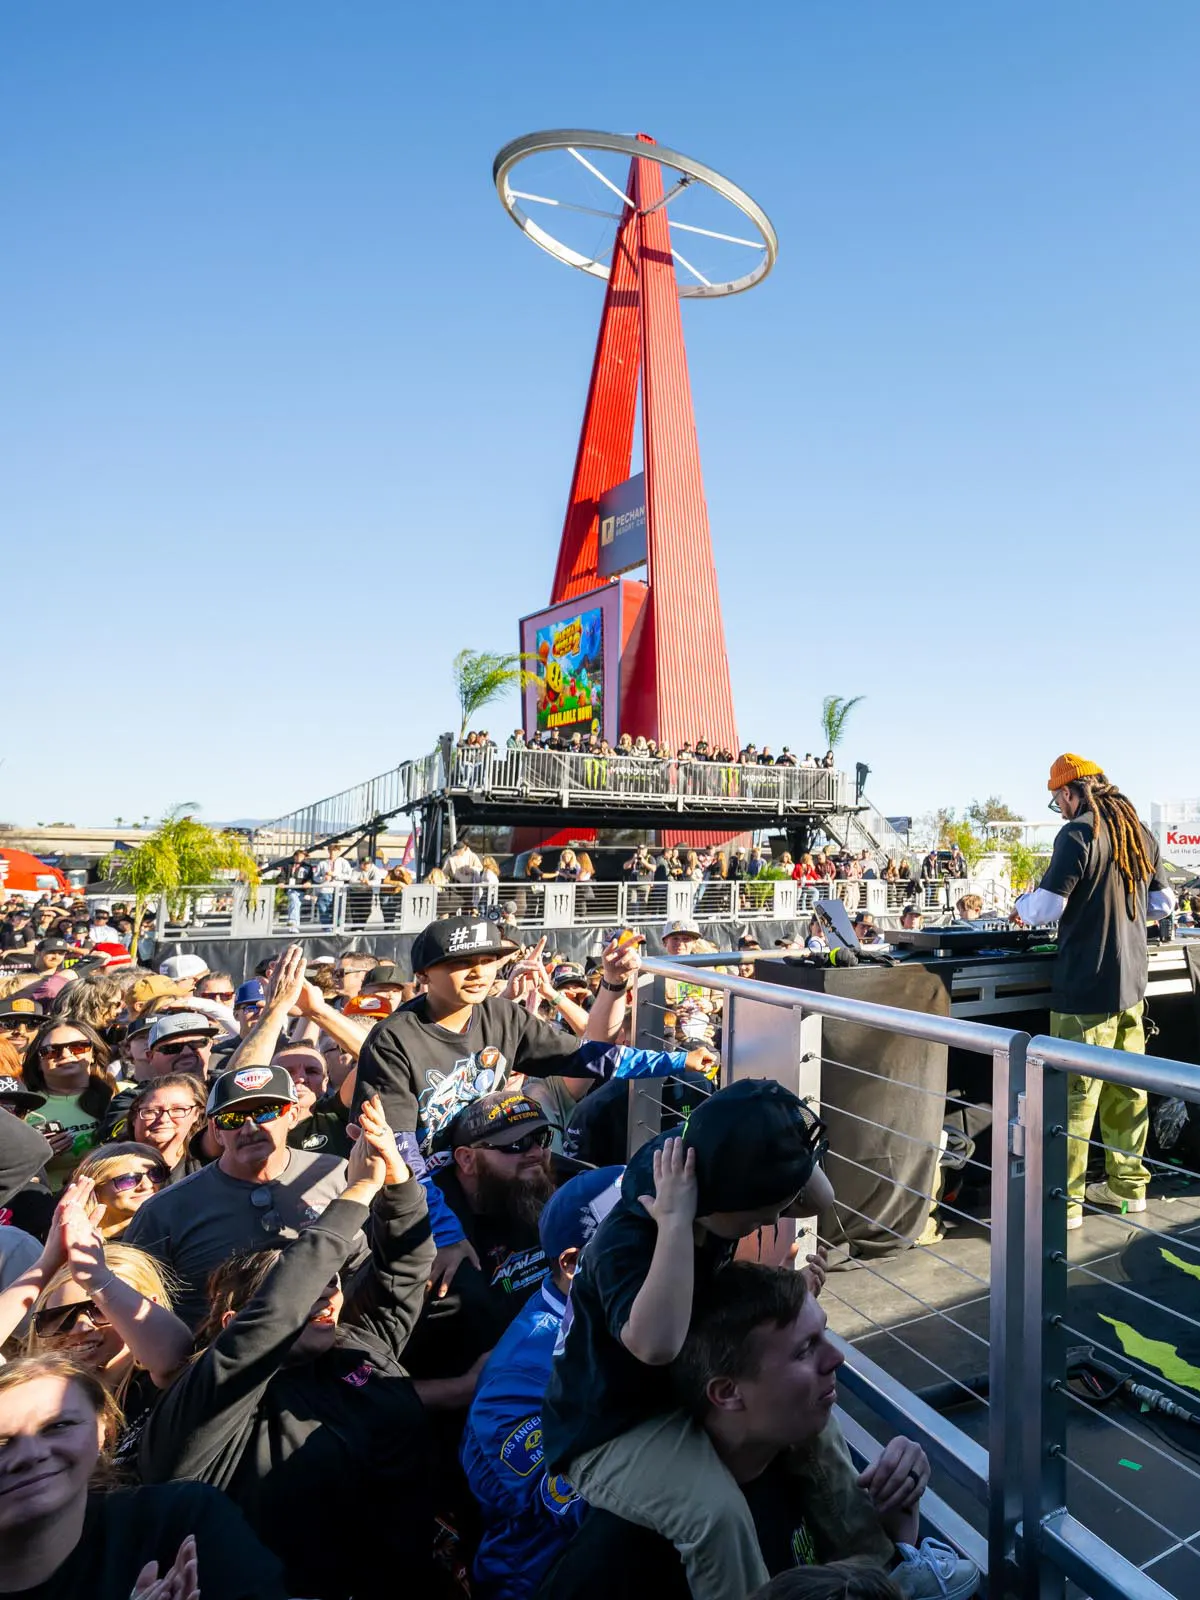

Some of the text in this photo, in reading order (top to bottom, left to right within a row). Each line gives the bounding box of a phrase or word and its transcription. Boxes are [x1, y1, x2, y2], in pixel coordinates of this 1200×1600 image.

[611, 766, 661, 777] MONSTER
[449, 922, 488, 945] #1
[448, 940, 493, 952] GRIPPER
[507, 1110, 539, 1124] VETERAN
[503, 1440, 516, 1459] LOS
[529, 1444, 544, 1463] RA
